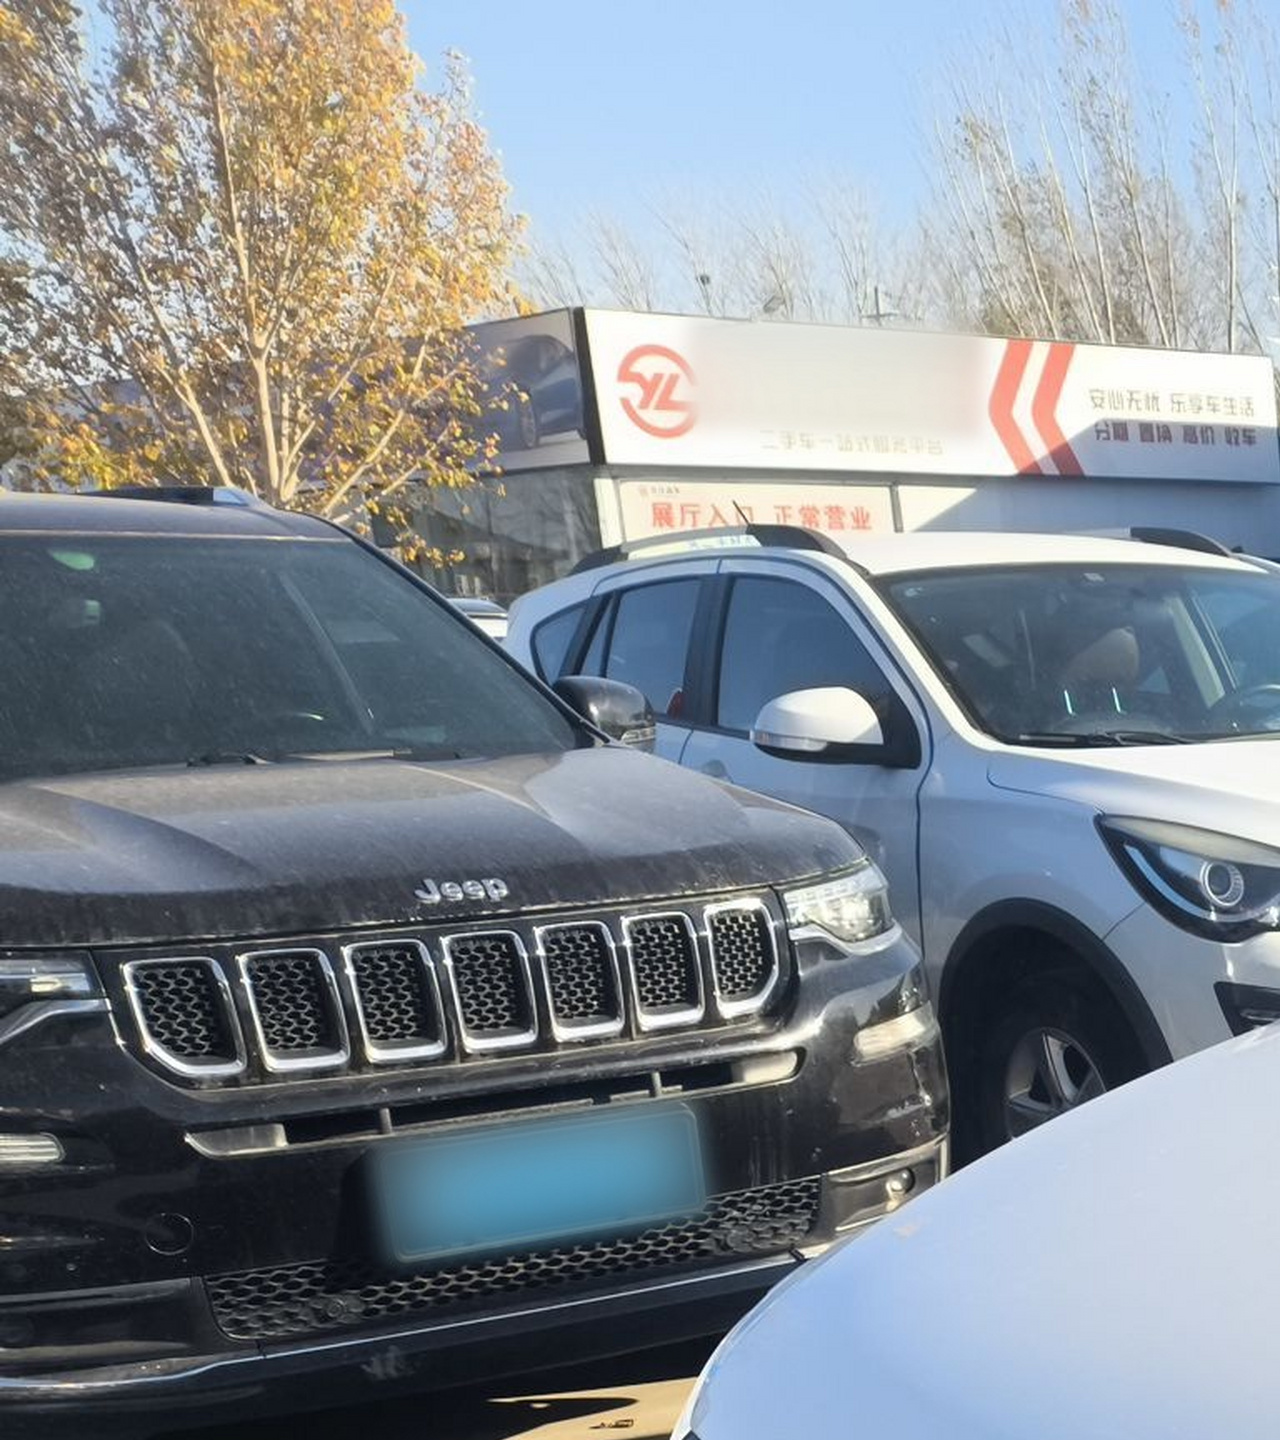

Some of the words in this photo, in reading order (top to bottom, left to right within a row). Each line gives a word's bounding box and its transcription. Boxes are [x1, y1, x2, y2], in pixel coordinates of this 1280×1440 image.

[1088, 388, 1161, 413] 安心无忧
[1170, 392, 1255, 418] 乐享车生活
[651, 501, 754, 530] 展厅入口
[773, 504, 872, 531] 正常营业
[414, 877, 509, 904] Jeep
